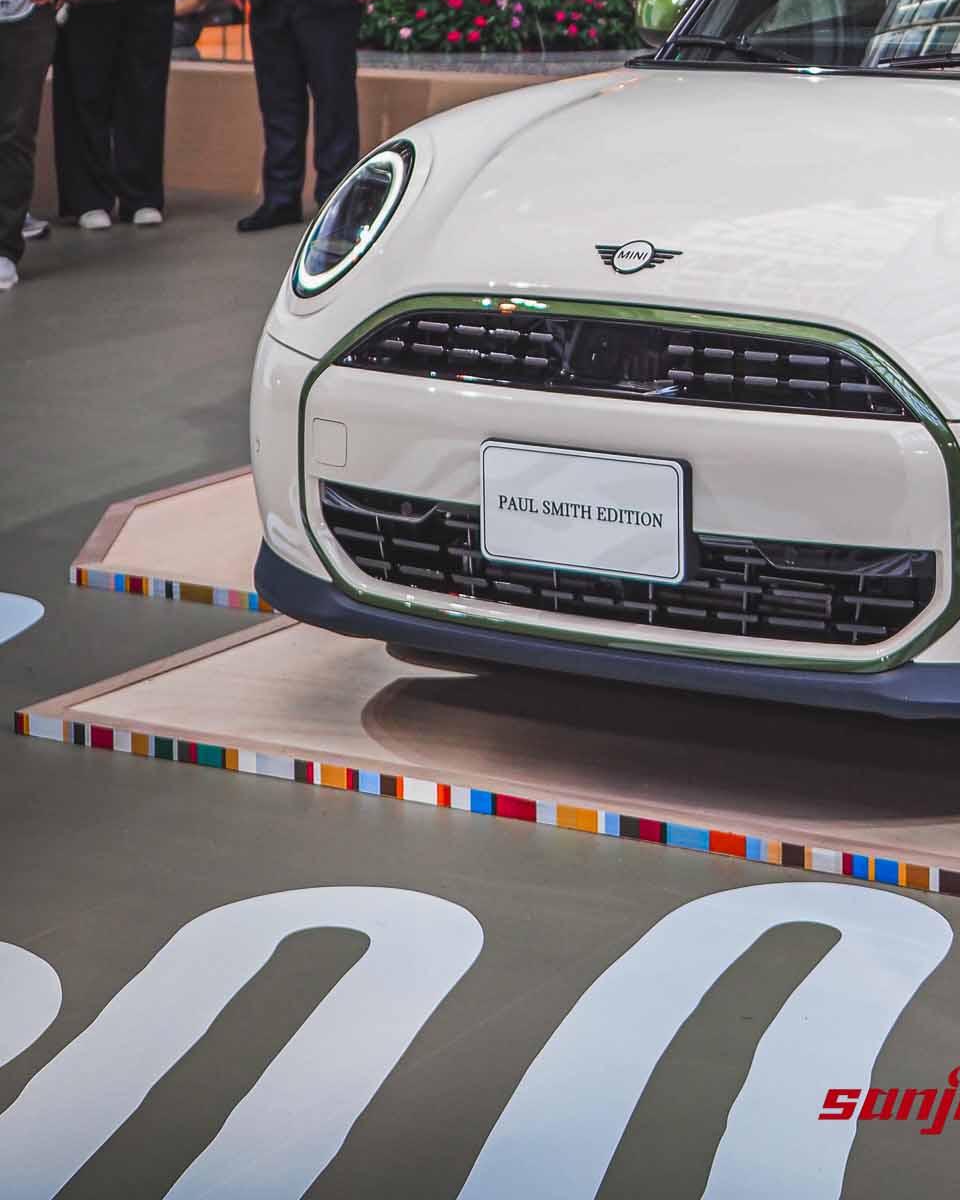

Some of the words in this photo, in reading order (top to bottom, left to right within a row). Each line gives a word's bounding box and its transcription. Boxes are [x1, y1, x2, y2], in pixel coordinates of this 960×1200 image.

[617, 250, 648, 261] MINI
[499, 495, 538, 513] PAUL
[542, 500, 592, 520] SMITH
[597, 506, 663, 528] EDITION
